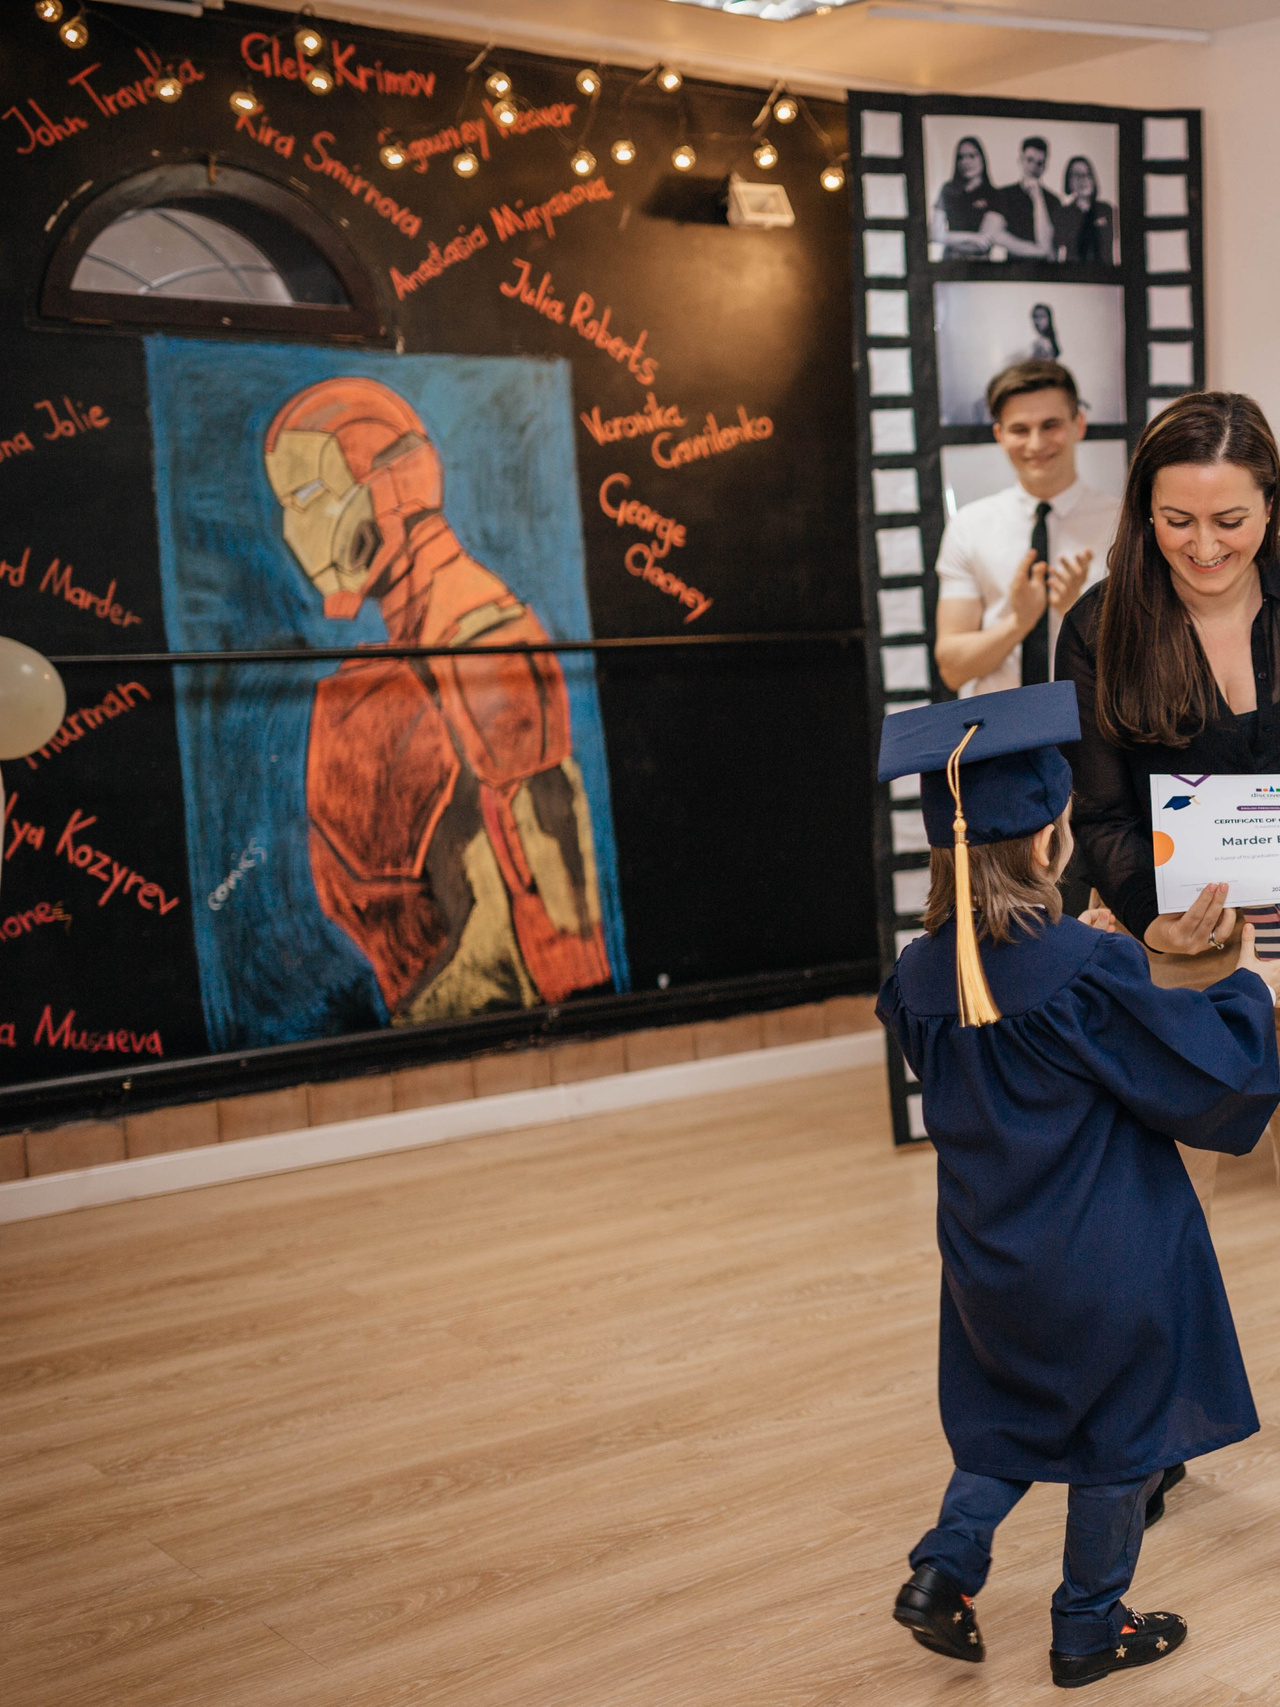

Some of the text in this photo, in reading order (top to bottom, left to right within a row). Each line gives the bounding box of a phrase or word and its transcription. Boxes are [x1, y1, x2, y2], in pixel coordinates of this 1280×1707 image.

[331, 39, 437, 98] Krimov
[1, 98, 89, 155] John
[303, 130, 423, 239] Smirnova
[499, 257, 660, 386] Julia Roberts
[33, 395, 110, 441] Jolie
[599, 472, 687, 558] George
[39, 557, 143, 628] Marder
[55, 808, 180, 916] Kozyrev
[1222, 835, 1273, 846] Marder
[33, 1003, 164, 1057] Musaeva
